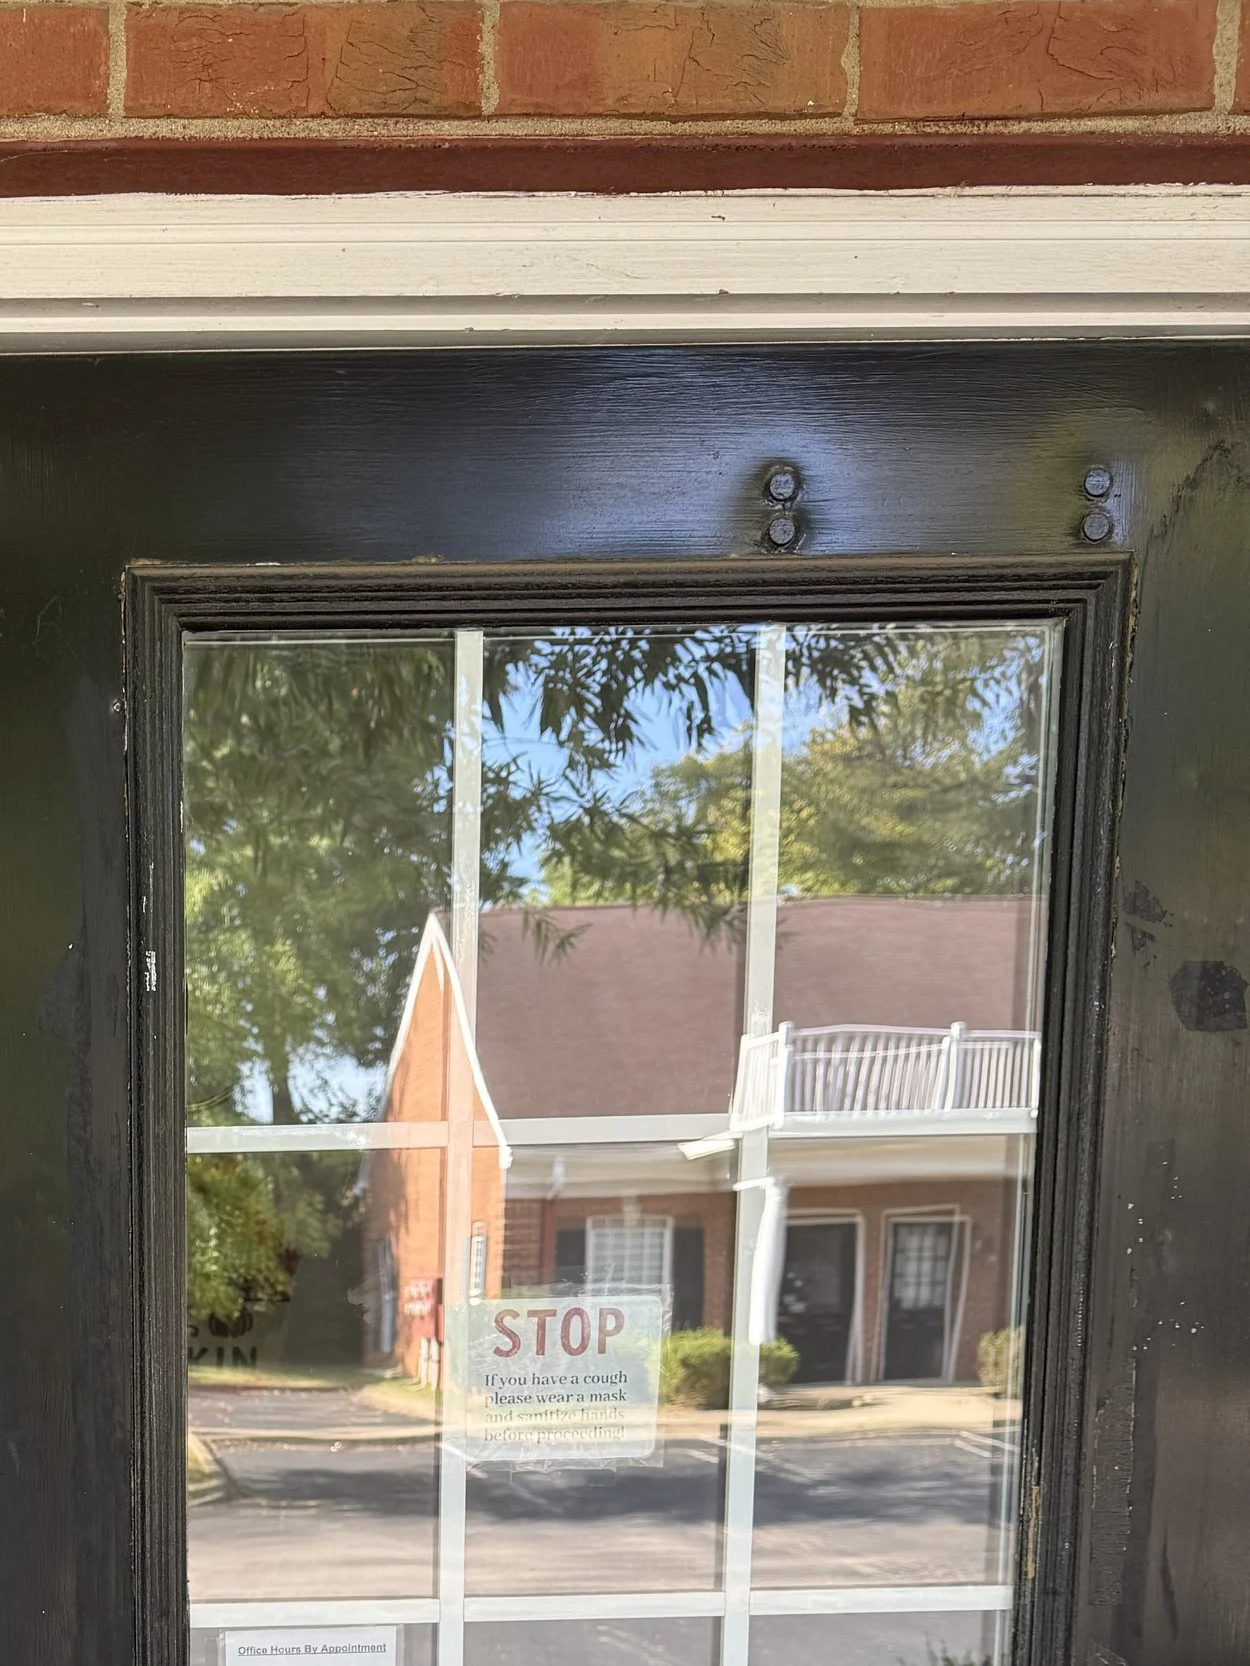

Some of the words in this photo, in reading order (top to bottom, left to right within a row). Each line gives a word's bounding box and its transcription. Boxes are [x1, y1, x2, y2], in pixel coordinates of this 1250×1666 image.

[493, 1307, 625, 1357] STOP
[485, 1374, 498, 1386] If
[499, 1376, 527, 1389] you
[532, 1373, 567, 1385] have
[570, 1375, 579, 1385] a
[583, 1371, 628, 1386] cough
[485, 1391, 532, 1407] please
[535, 1393, 574, 1403] wear
[576, 1393, 585, 1402] a
[589, 1389, 627, 1402] mask
[485, 1410, 513, 1423] and
[581, 1407, 625, 1421] hands
[484, 1428, 533, 1442] before
[537, 1426, 625, 1444] proceeding!
[238, 1646, 268, 1656] Office
[270, 1645, 301, 1655] Hours
[304, 1645, 318, 1655] By
[321, 1643, 387, 1654] Appointment
